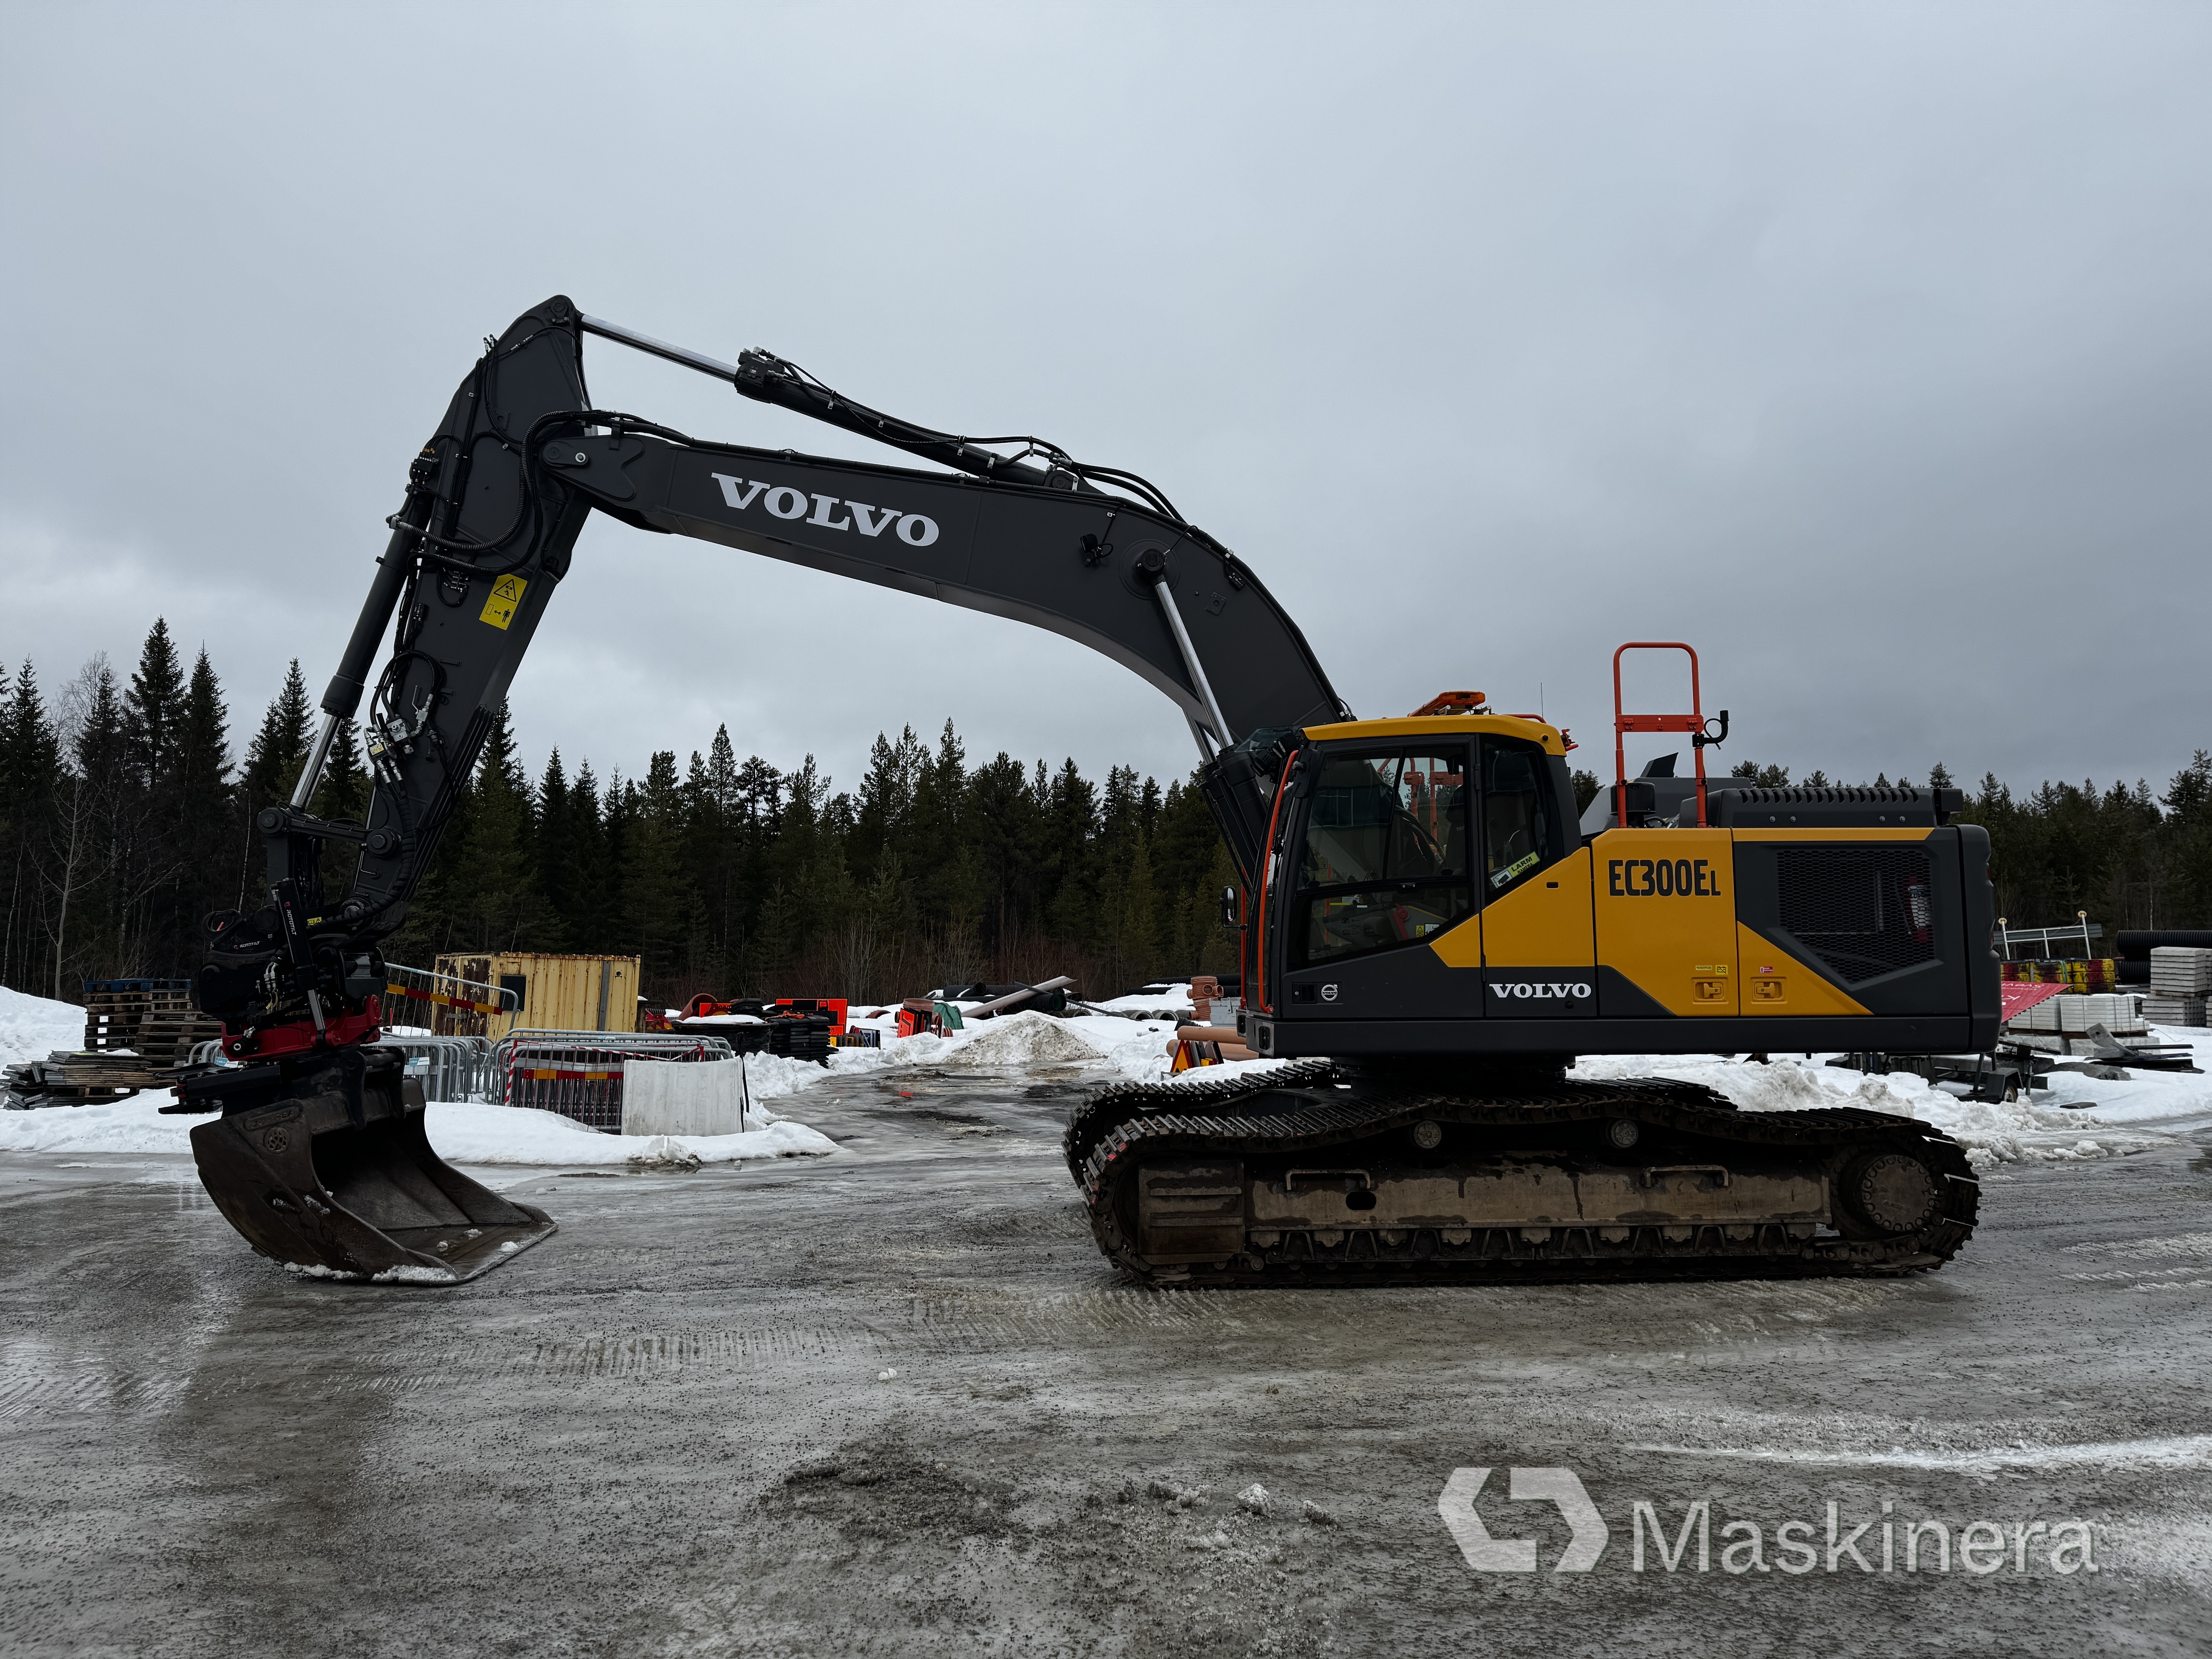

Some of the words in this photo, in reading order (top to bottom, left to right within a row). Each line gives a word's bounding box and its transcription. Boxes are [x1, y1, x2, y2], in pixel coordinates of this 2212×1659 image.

[711, 472, 939, 546] VOLVO
[1511, 856, 1533, 872] LARM
[1608, 859, 1721, 896] EC300EL
[287, 909, 297, 936] ROTOTILT
[1489, 983, 1591, 998] VOLVO
